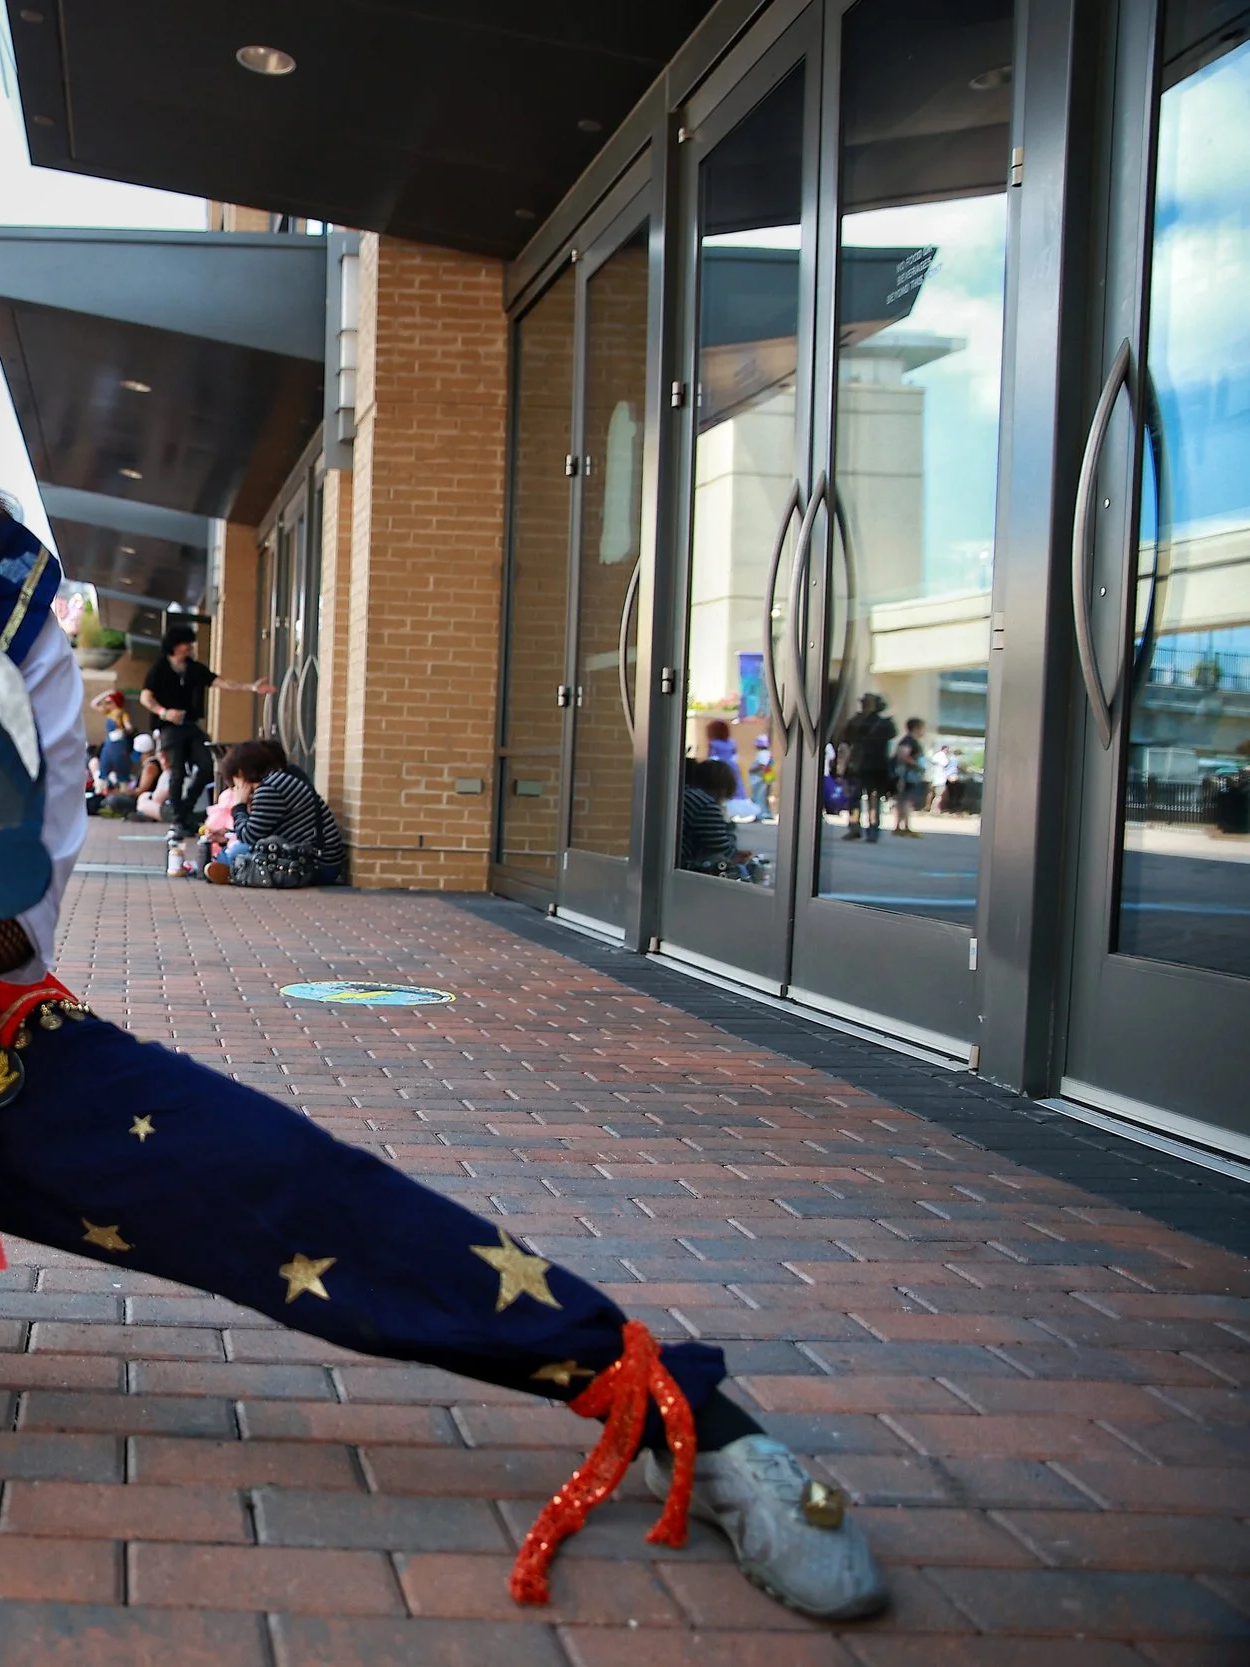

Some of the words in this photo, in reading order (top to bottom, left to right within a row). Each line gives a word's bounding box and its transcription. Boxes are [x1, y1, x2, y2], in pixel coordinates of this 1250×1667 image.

[896, 256, 932, 286] BEVERAGES
[905, 249, 922, 266] FOOD
[886, 283, 910, 305] BEYOND
[910, 274, 925, 290] THIS
